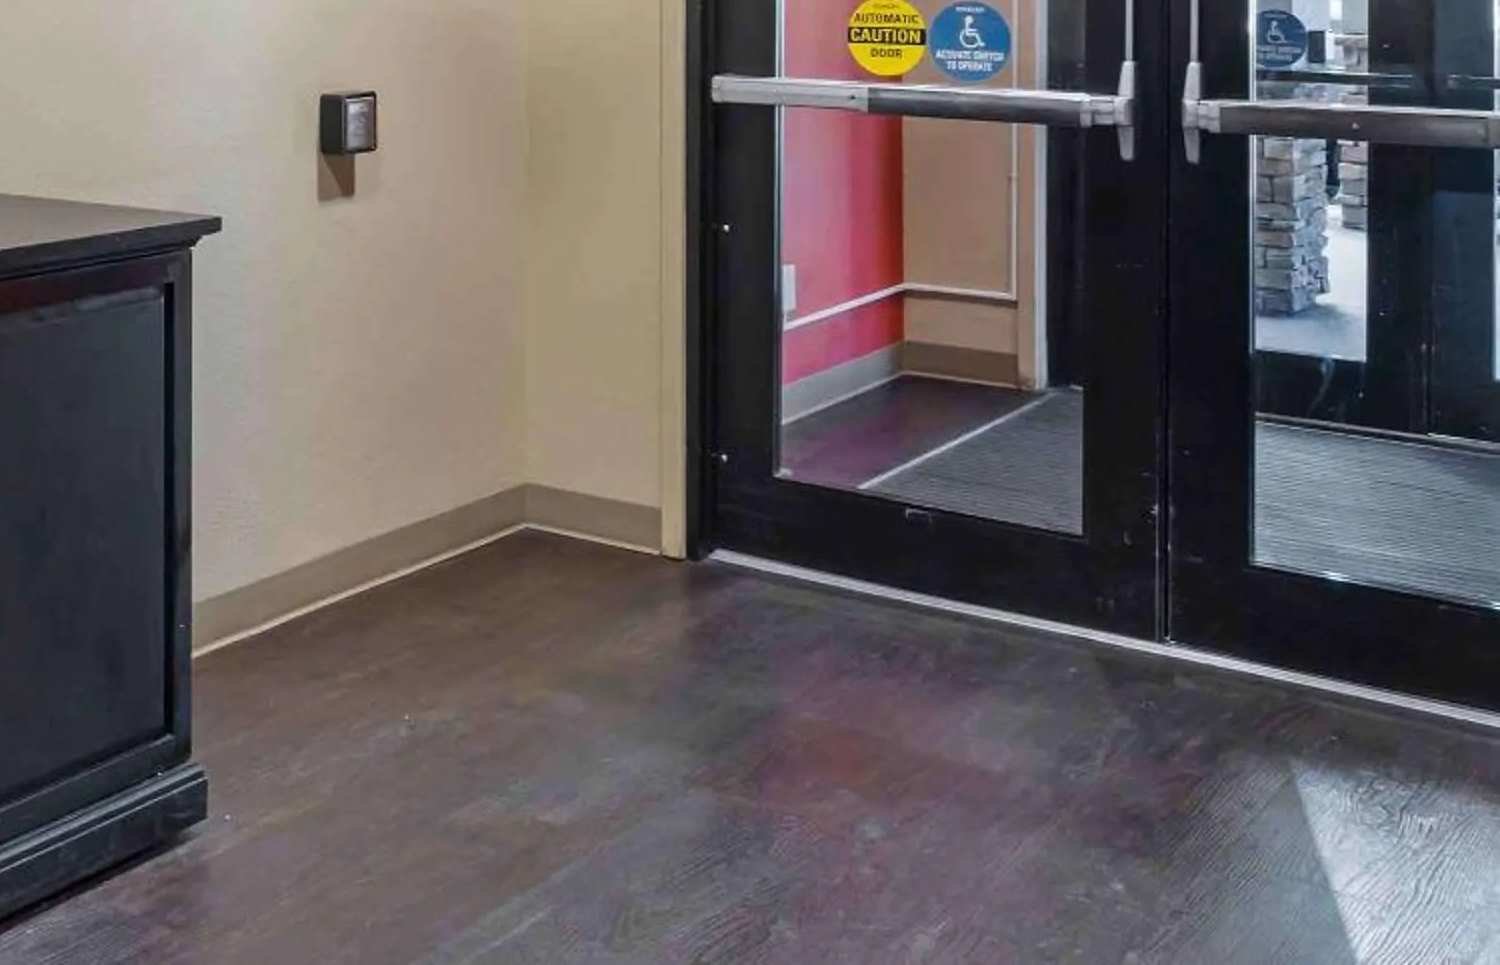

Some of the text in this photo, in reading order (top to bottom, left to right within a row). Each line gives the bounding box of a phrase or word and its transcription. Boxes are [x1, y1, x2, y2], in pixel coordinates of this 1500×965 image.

[853, 12, 920, 24] AUTOMATIC
[850, 28, 921, 44] CAUTION
[870, 47, 903, 60] DOOR
